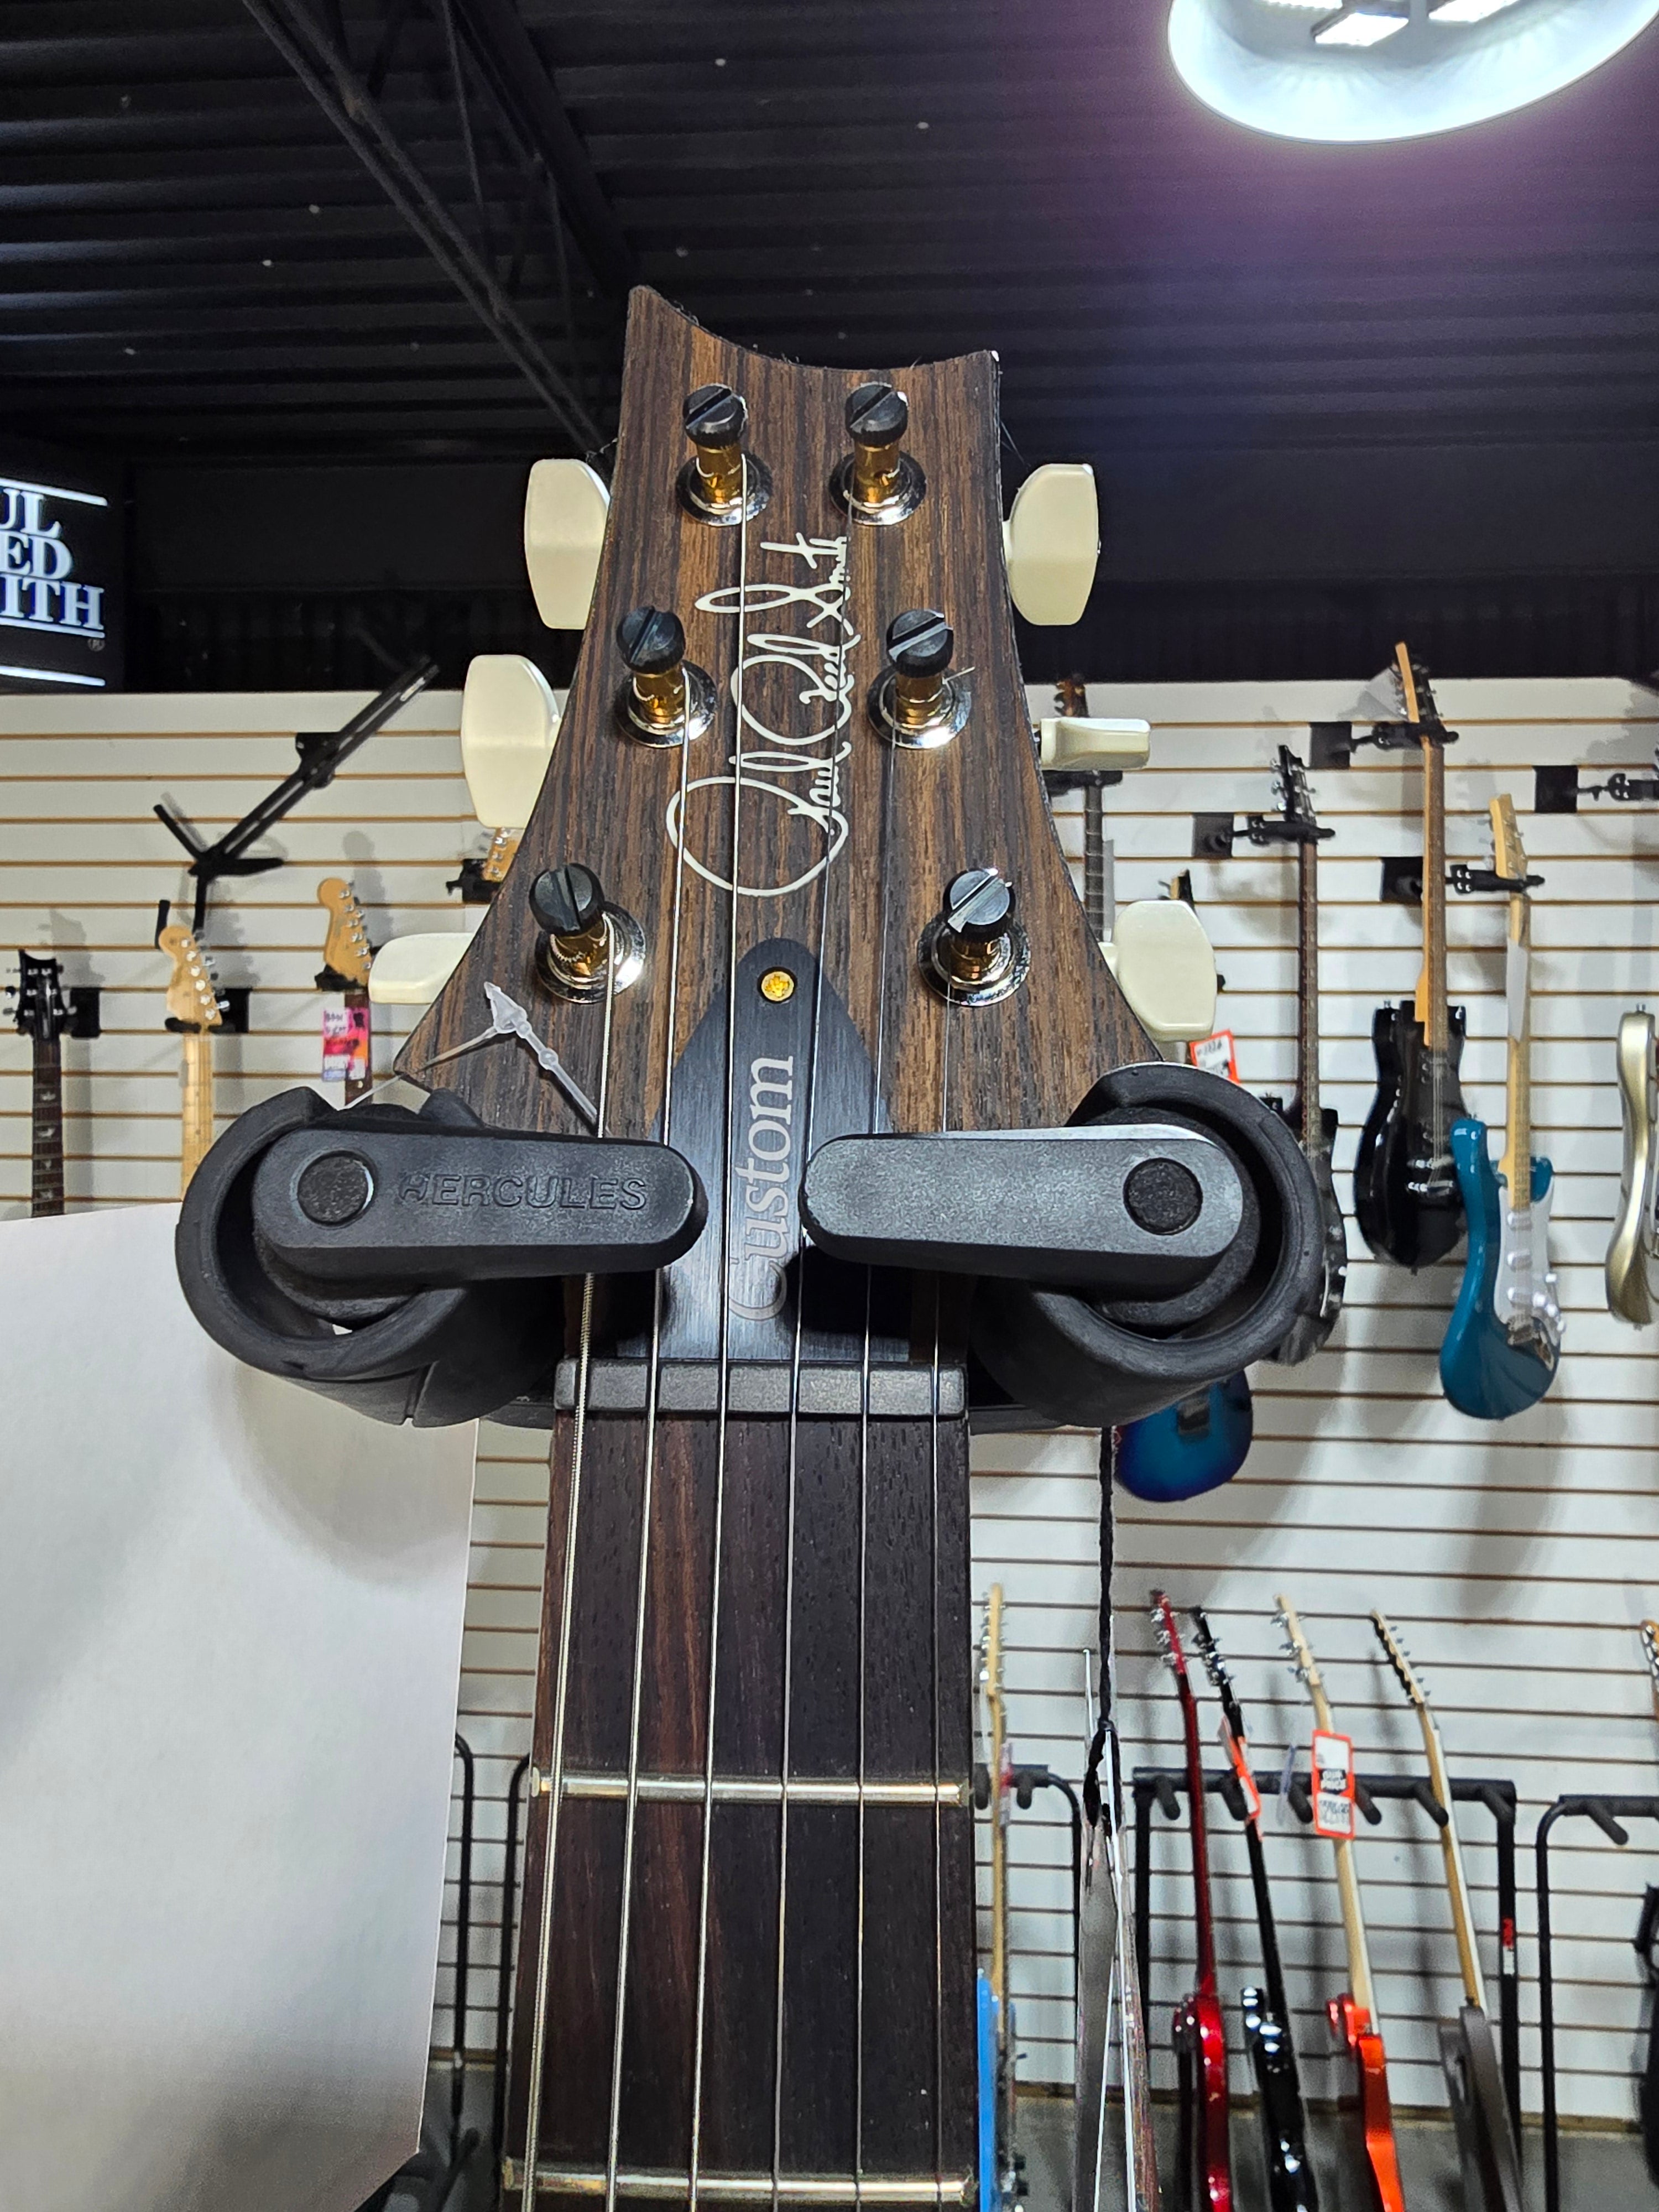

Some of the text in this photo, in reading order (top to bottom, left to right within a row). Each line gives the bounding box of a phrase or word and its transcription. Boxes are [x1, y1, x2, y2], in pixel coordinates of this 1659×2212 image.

[1, 574, 105, 630] ITH
[666, 532, 861, 897] Paul Reed Smith
[398, 1172, 648, 1211] HERCULES
[728, 1055, 794, 1322] Custom
